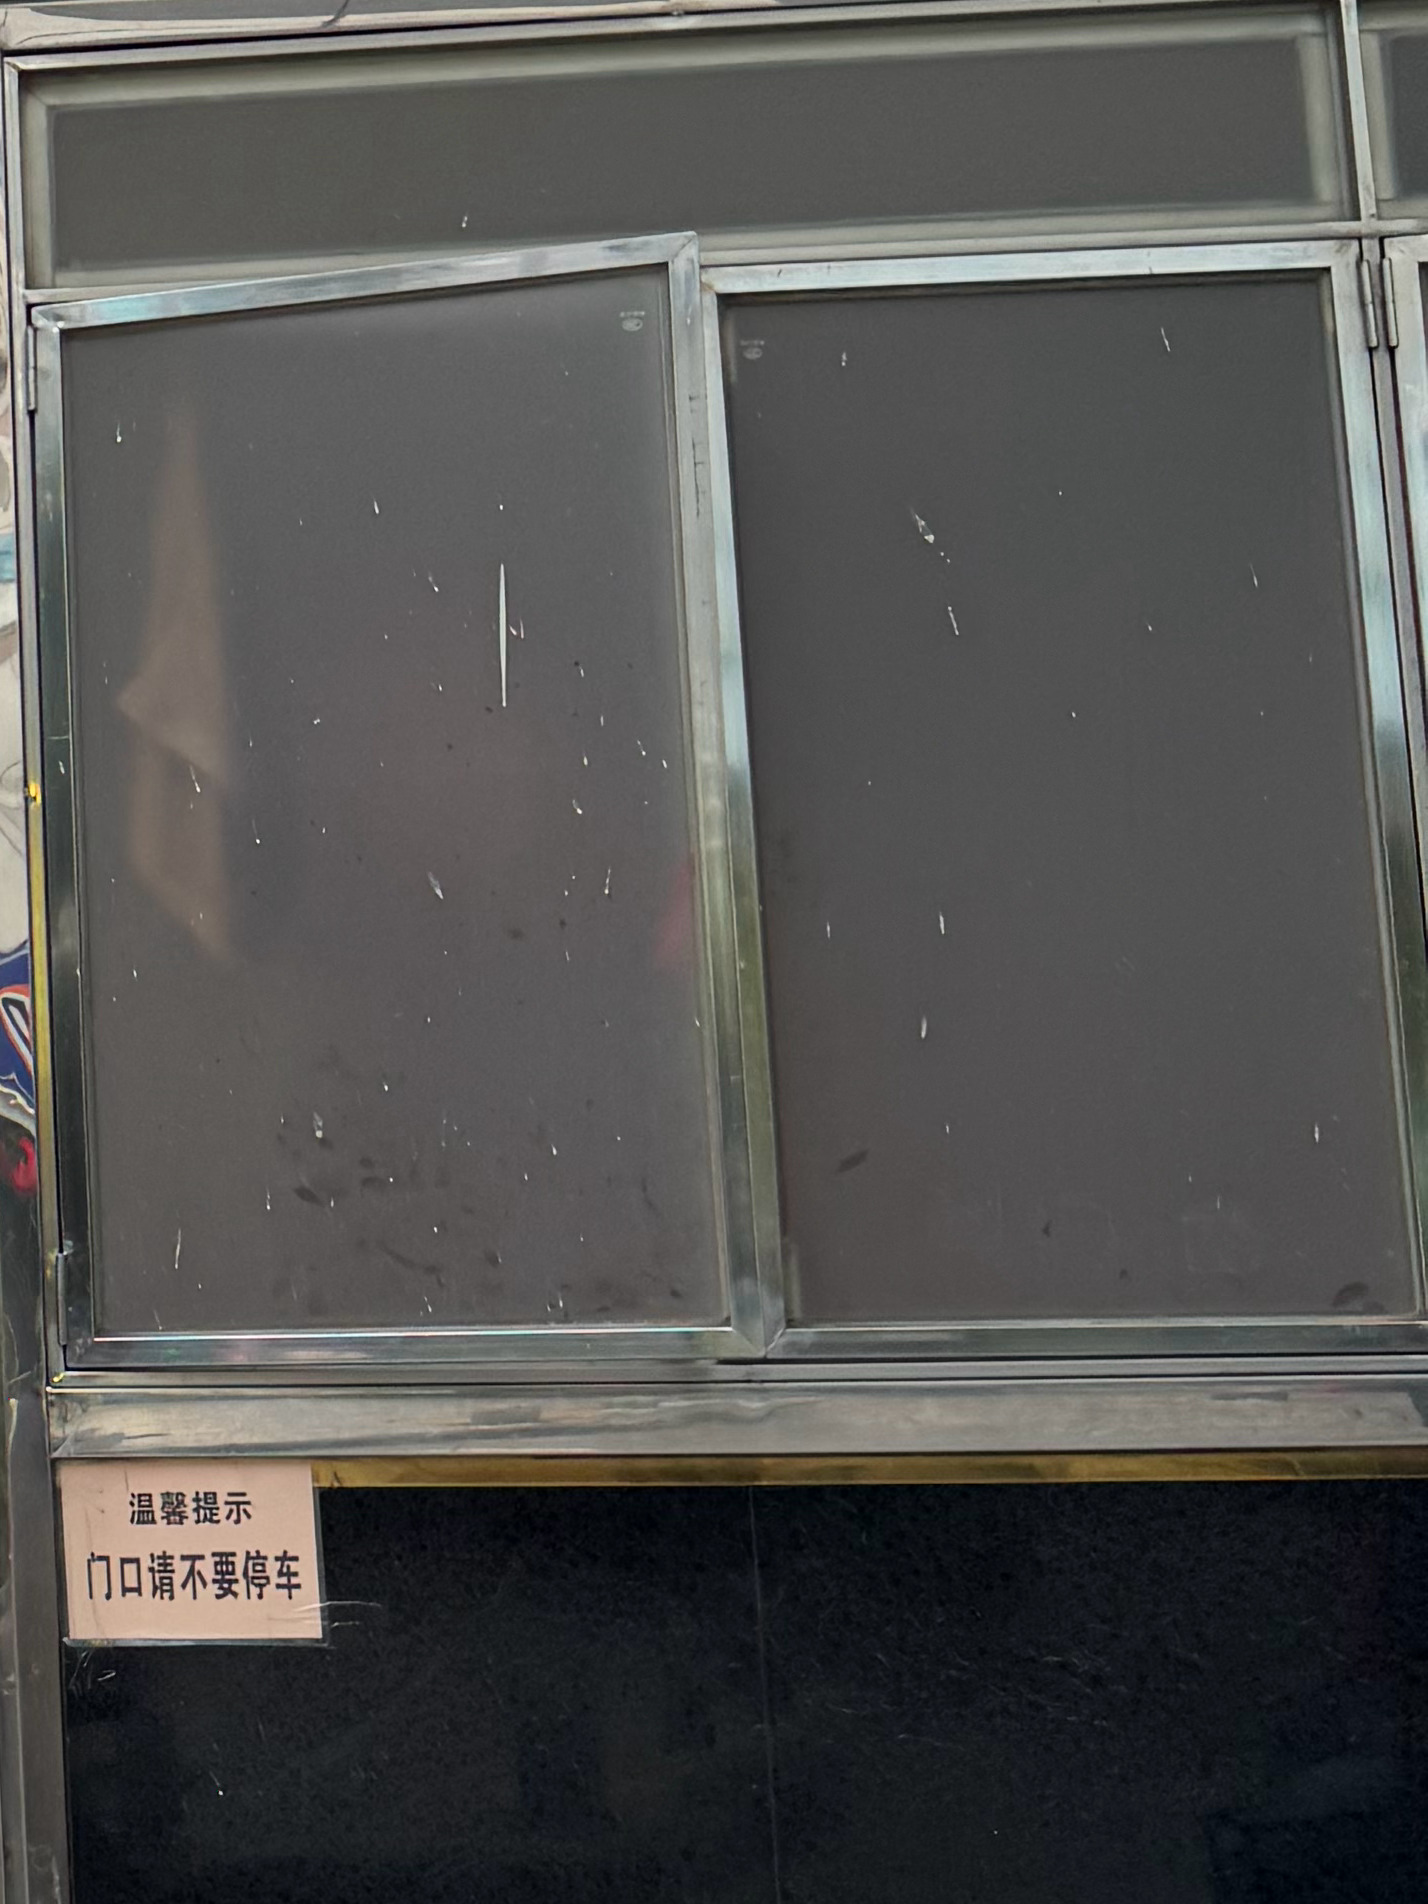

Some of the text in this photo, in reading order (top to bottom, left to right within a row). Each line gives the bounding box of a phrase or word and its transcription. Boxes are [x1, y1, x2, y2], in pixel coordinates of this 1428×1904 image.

[129, 1491, 253, 1525] 温馨提示
[86, 1549, 302, 1601] 门口请不要停车
